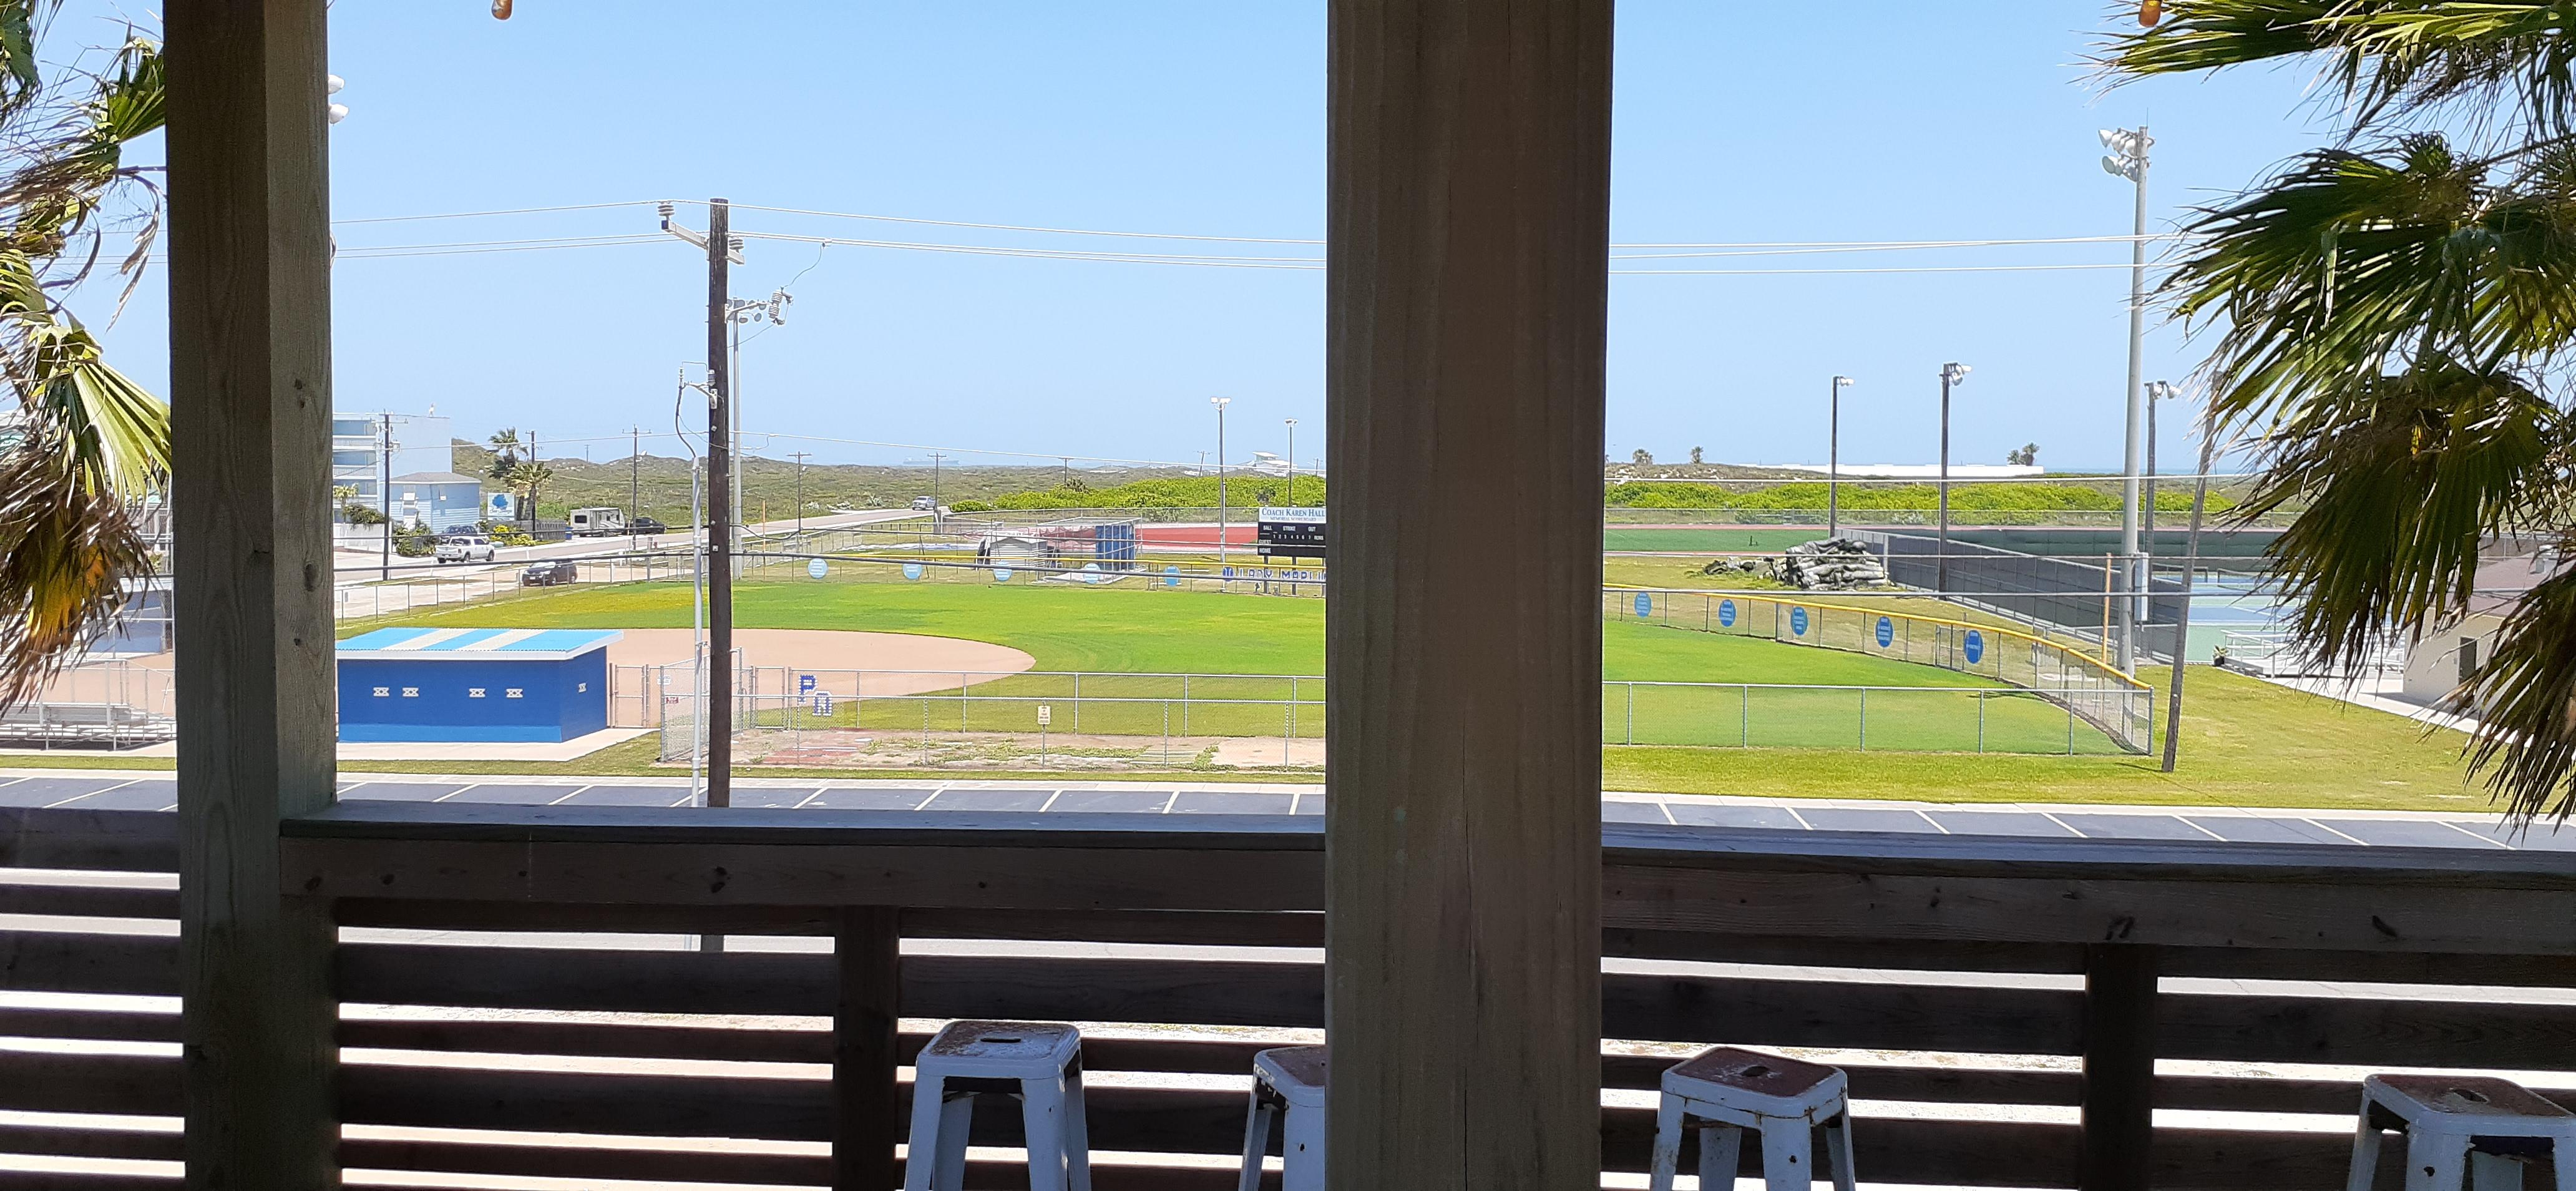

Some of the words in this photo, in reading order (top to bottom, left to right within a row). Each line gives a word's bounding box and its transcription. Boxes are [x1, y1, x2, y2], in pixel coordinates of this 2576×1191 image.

[1262, 508, 1284, 516] COACH
[1286, 508, 1307, 517] KAREN
[1308, 509, 1325, 517] HALL
